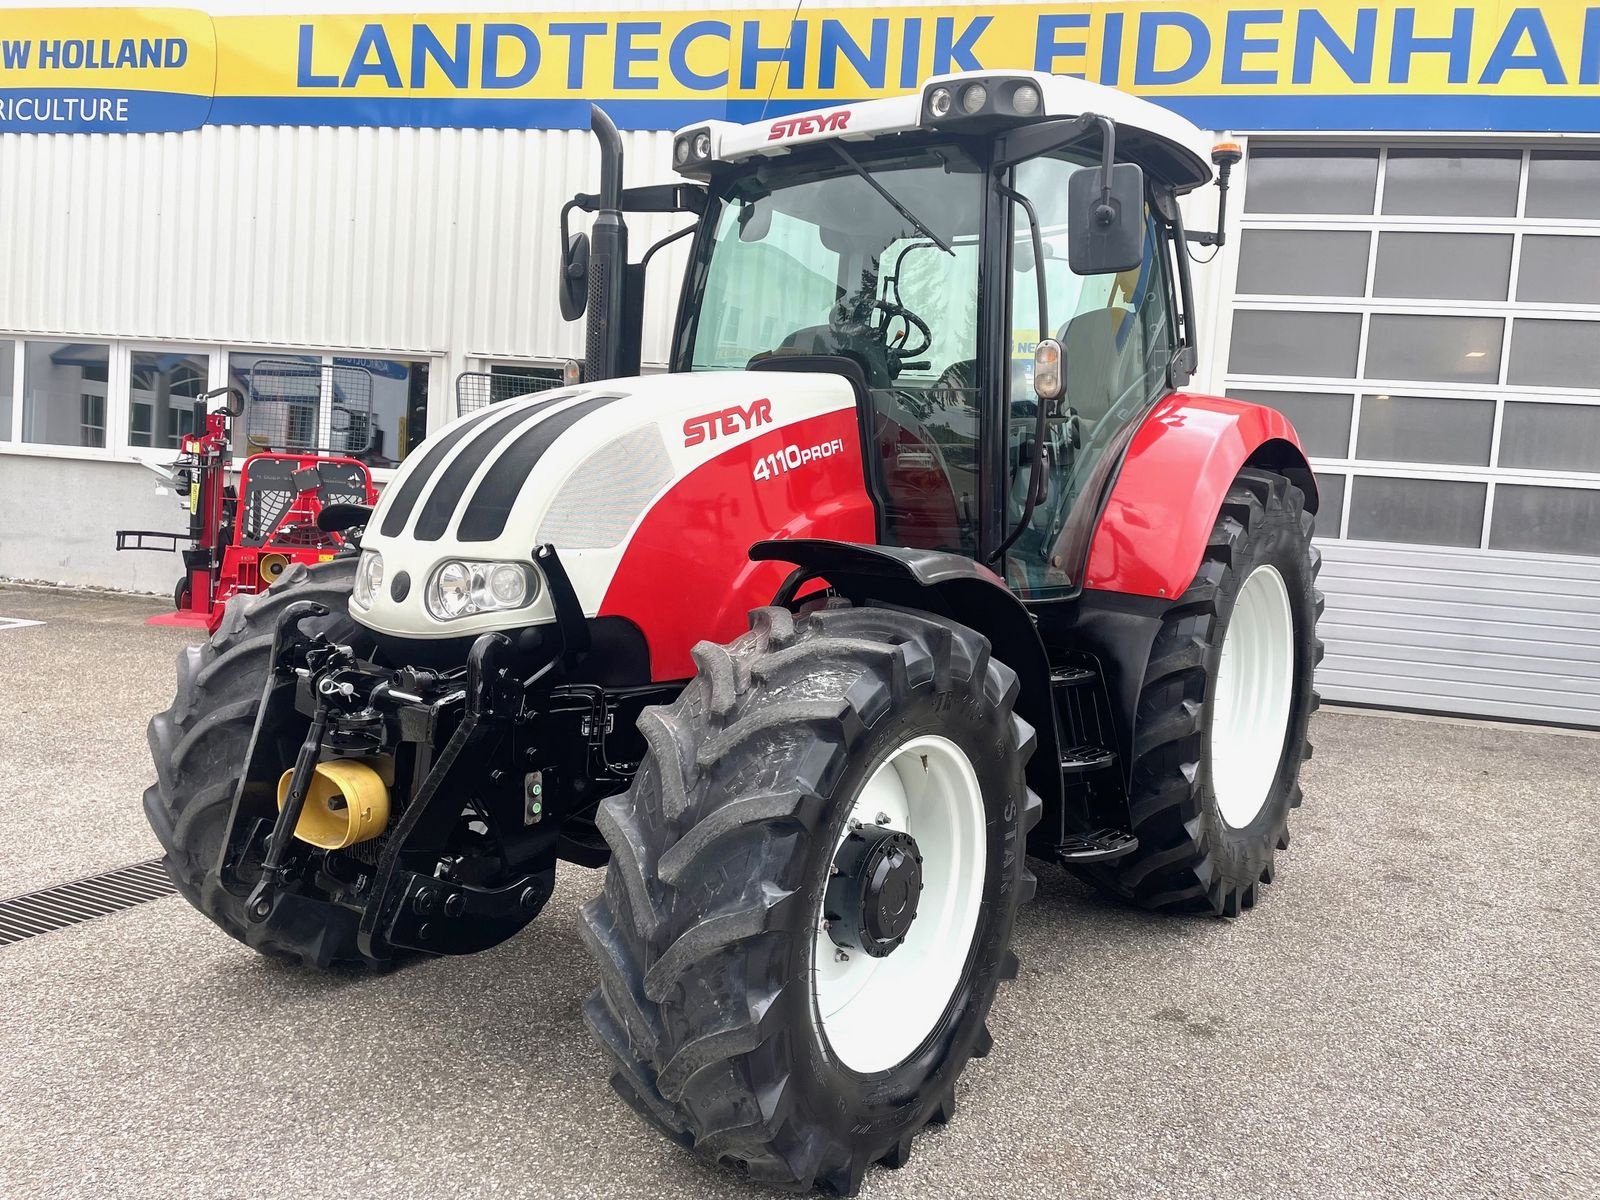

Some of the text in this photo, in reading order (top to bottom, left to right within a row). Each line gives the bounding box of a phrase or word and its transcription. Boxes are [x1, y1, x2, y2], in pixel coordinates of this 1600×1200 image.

[2, 38, 188, 69] W HOLLAND
[297, 15, 995, 90] LANDTECHNIK
[768, 111, 851, 141] STEYR
[683, 398, 773, 448] STEYR
